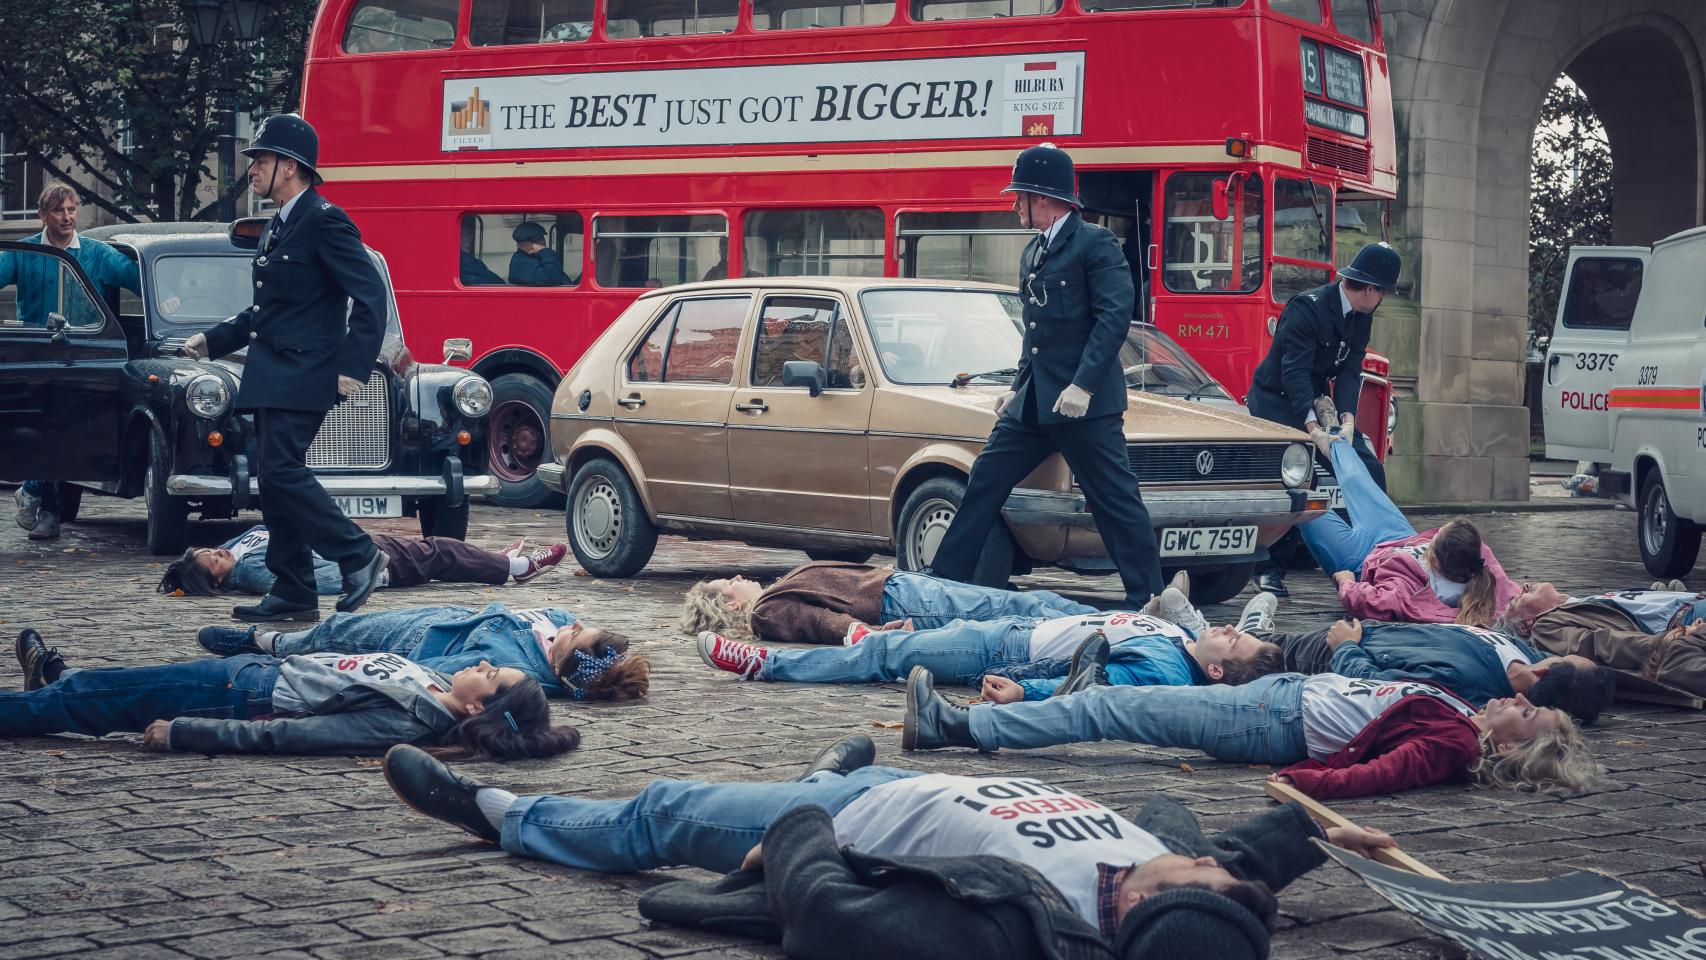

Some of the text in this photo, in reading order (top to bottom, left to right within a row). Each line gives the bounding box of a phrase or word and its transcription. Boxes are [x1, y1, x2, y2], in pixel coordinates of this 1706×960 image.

[1014, 77, 1065, 93] HILBURN
[500, 79, 993, 133] THE BEST JUST GOT BIGGER!
[1013, 101, 1065, 112] KING SIZE
[1178, 324, 1229, 339] RM 471
[1575, 352, 1619, 372] 3379
[1638, 366, 1659, 385] 3379
[333, 497, 388, 515] M 19W
[1163, 528, 1256, 551] GWC 759Y
[990, 797, 1102, 820] NEEDS
[1016, 813, 1124, 848] AIDS
